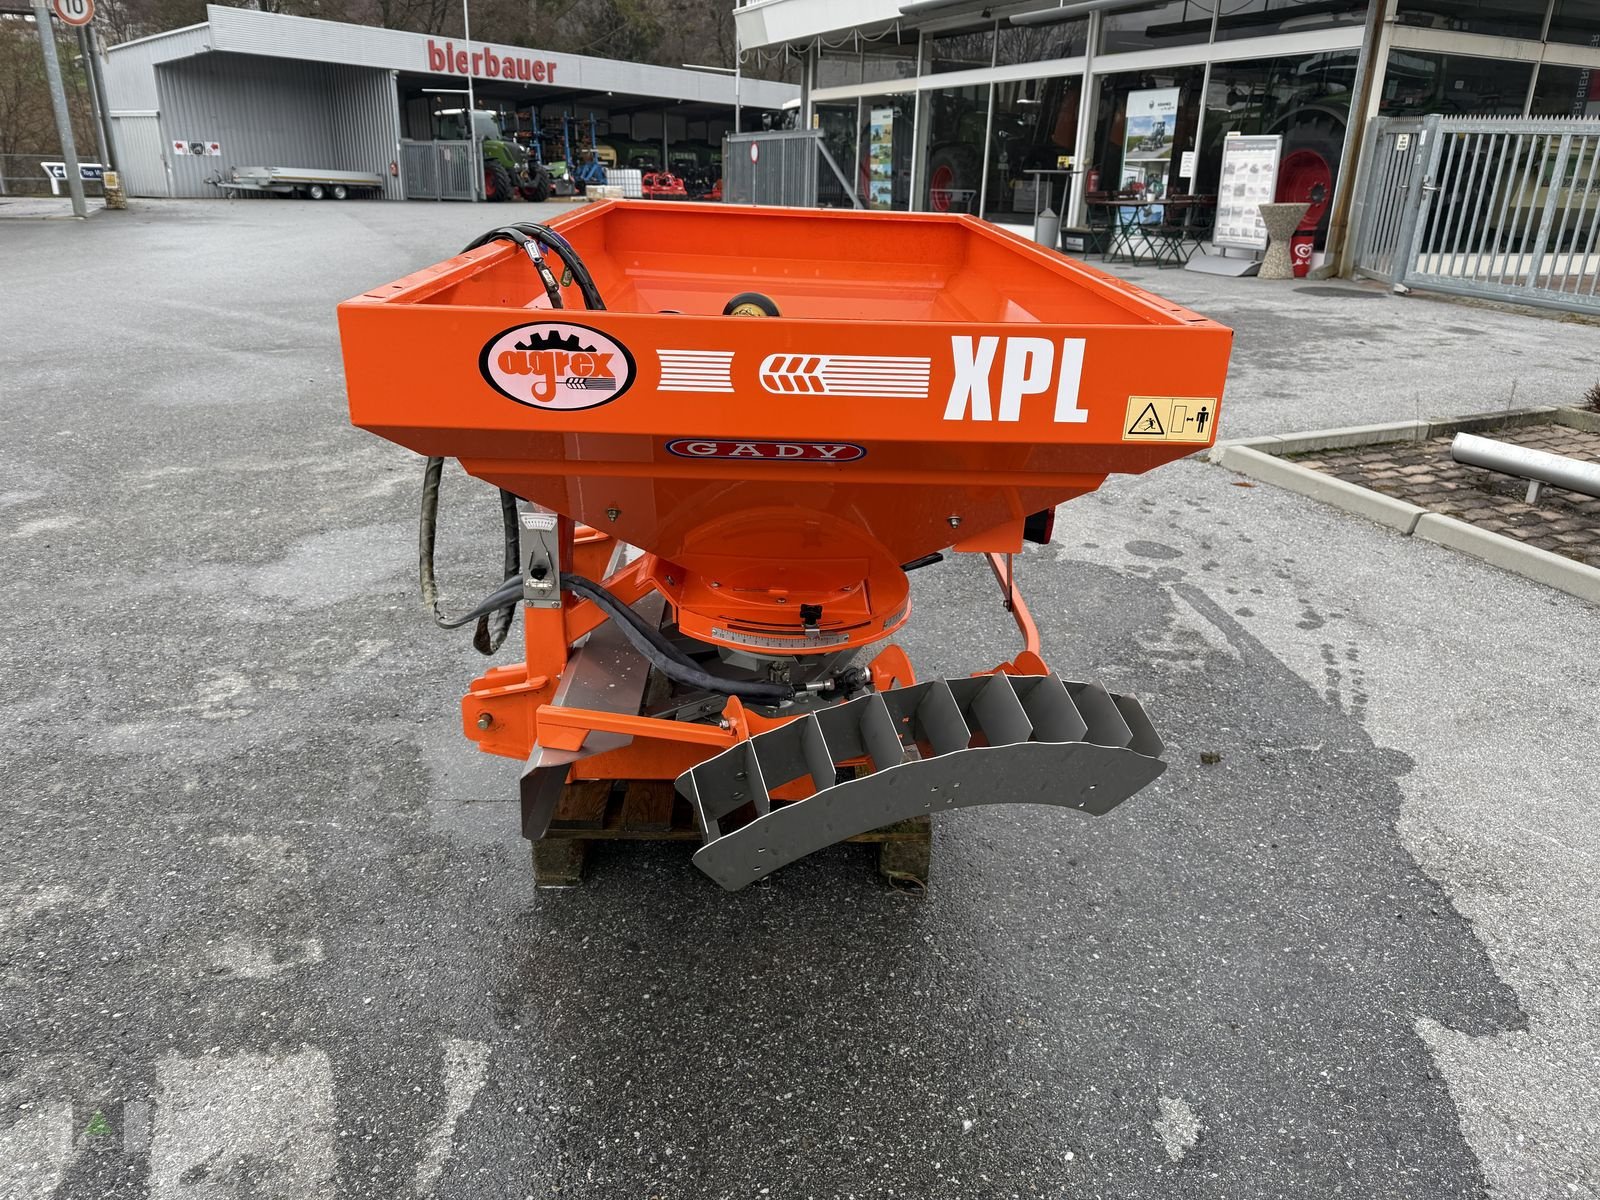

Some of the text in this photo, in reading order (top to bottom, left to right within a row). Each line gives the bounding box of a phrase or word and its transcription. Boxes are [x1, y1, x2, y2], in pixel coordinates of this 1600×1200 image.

[66, 0, 83, 14] 10
[428, 39, 557, 84] bierbauer
[497, 350, 615, 402] agrex
[943, 335, 1089, 423] XPL
[687, 442, 847, 459] GADY
